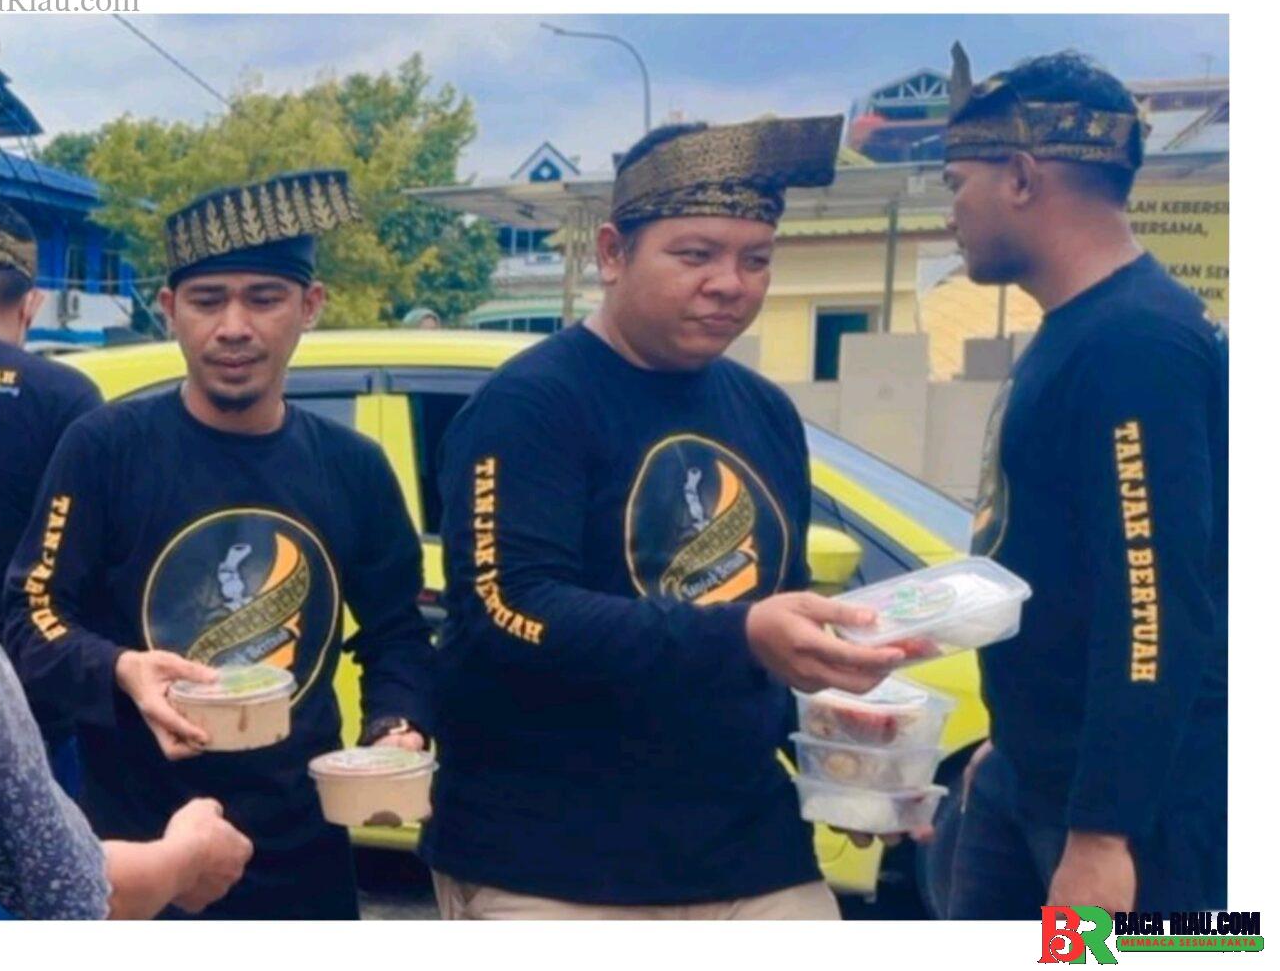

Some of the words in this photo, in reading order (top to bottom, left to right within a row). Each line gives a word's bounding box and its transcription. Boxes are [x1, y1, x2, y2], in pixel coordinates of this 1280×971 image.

[474, 456, 497, 568] TANJAK
[1115, 420, 1151, 541] TANJAK
[1127, 546, 1158, 683] BERTUAH
